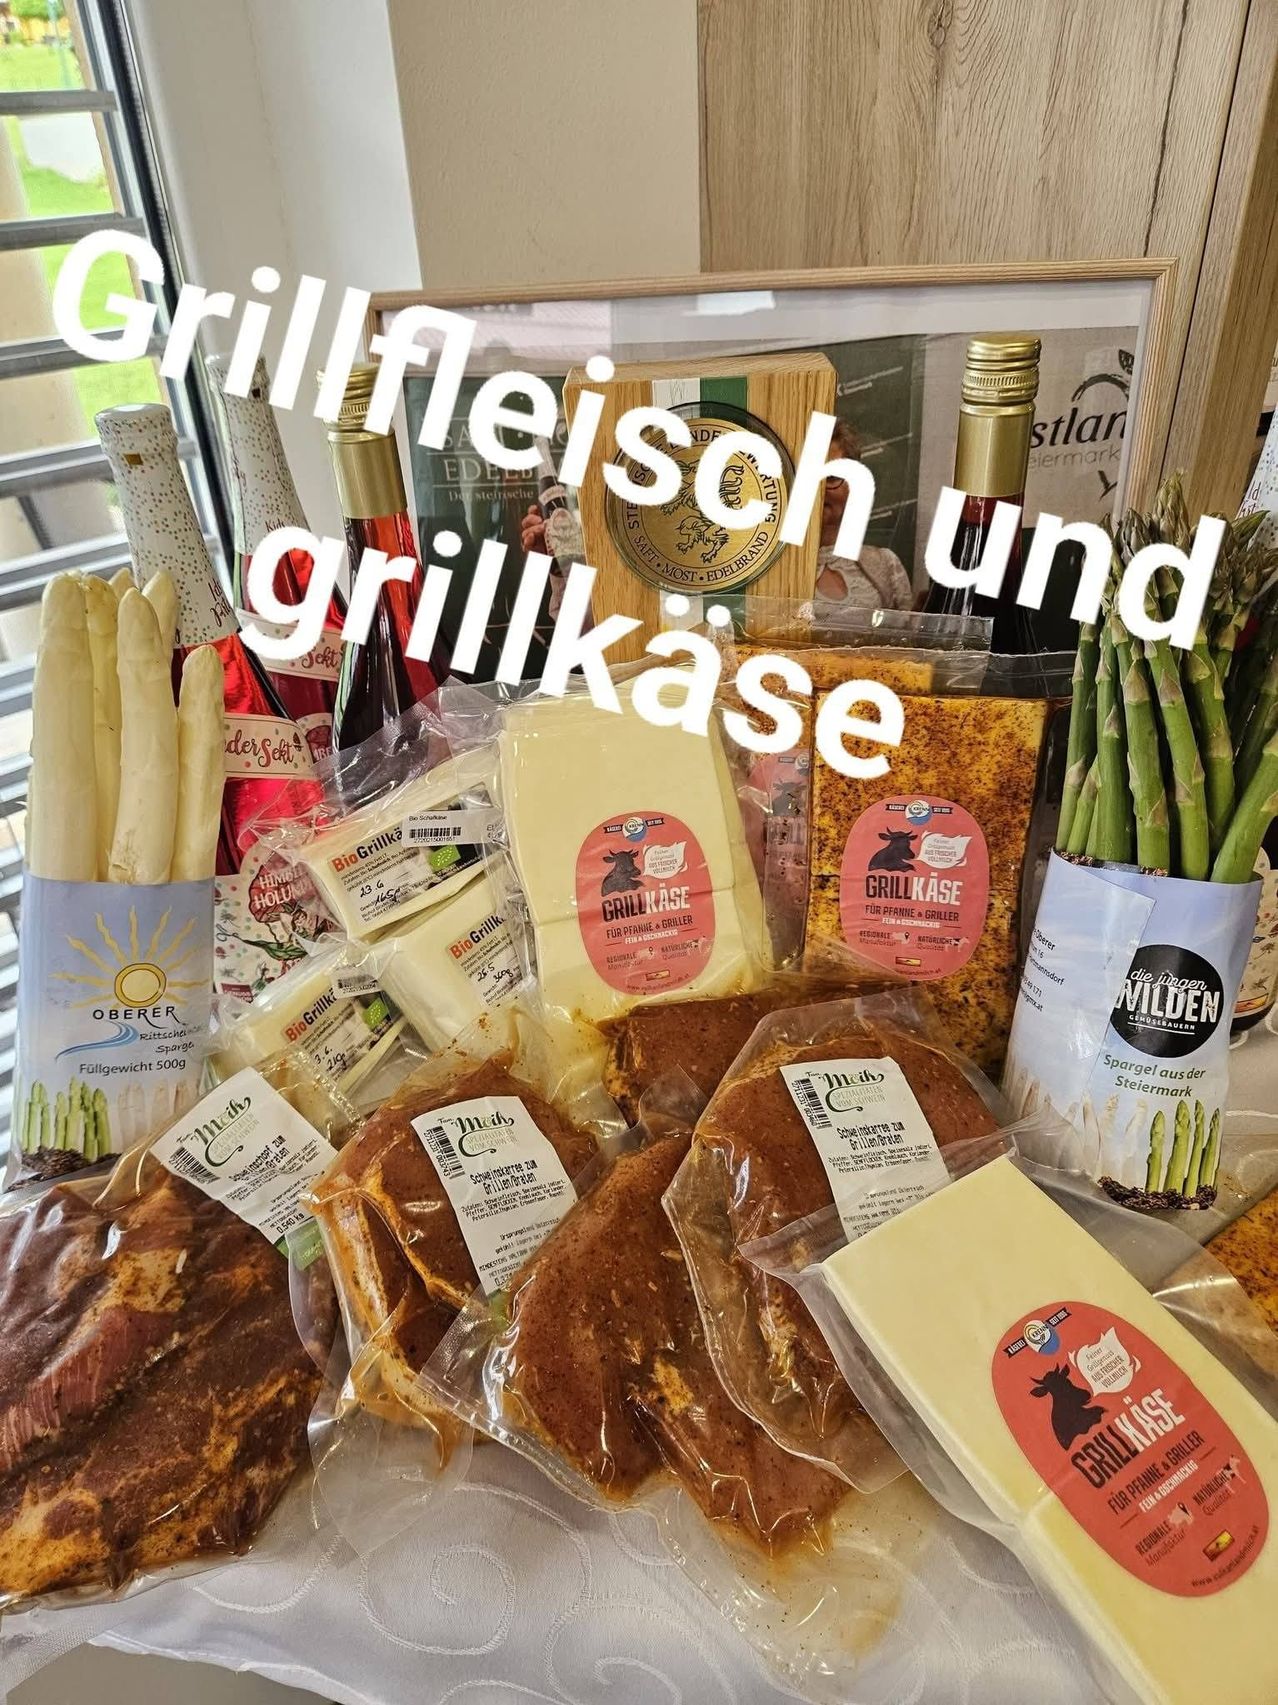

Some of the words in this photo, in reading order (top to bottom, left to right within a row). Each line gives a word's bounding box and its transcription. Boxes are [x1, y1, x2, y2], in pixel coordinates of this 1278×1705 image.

[1031, 407, 1127, 448] stlan
[634, 535, 660, 564] SAFT
[662, 563, 697, 582] MOST
[706, 531, 769, 582] EDELBRAND
[865, 872, 963, 905] GRILLKÄSE
[602, 883, 691, 922] GRILLKÄSE
[865, 903, 881, 914] FÜR
[883, 906, 915, 917] PFANNE
[925, 910, 959, 921] GRILLER
[606, 927, 622, 939] FÜR
[624, 922, 654, 936] PFANNE
[661, 915, 693, 929] GRILLER
[1130, 968, 1154, 983] die
[1152, 970, 1207, 994] jungen
[92, 1006, 184, 1028] OBERER
[1129, 1014, 1195, 1030] GEMÜSEBAUERN
[79, 1061, 153, 1077] Füllgewicht
[156, 1059, 186, 1070] 500g
[1104, 1054, 1158, 1076] Spargel
[1160, 1067, 1185, 1080] aus
[1186, 1067, 1206, 1079] der
[1115, 1076, 1192, 1097] Steiermark
[836, 1122, 891, 1140] Schweinskarree
[891, 1121, 906, 1132] zum
[849, 1133, 904, 1151] Grillen/Braten
[469, 1162, 524, 1185] Schweinskarree
[525, 1159, 538, 1171] zum
[483, 1171, 537, 1196] Grillen/Braten
[1071, 1388, 1186, 1489] GRILLKÄSE
[1107, 1491, 1131, 1515] FÜR
[1125, 1463, 1165, 1500] PFANNE
[1165, 1430, 1205, 1466] GRILLER
[1138, 1494, 1157, 1513] FEIN
[1135, 1520, 1172, 1557] REGIONALE
